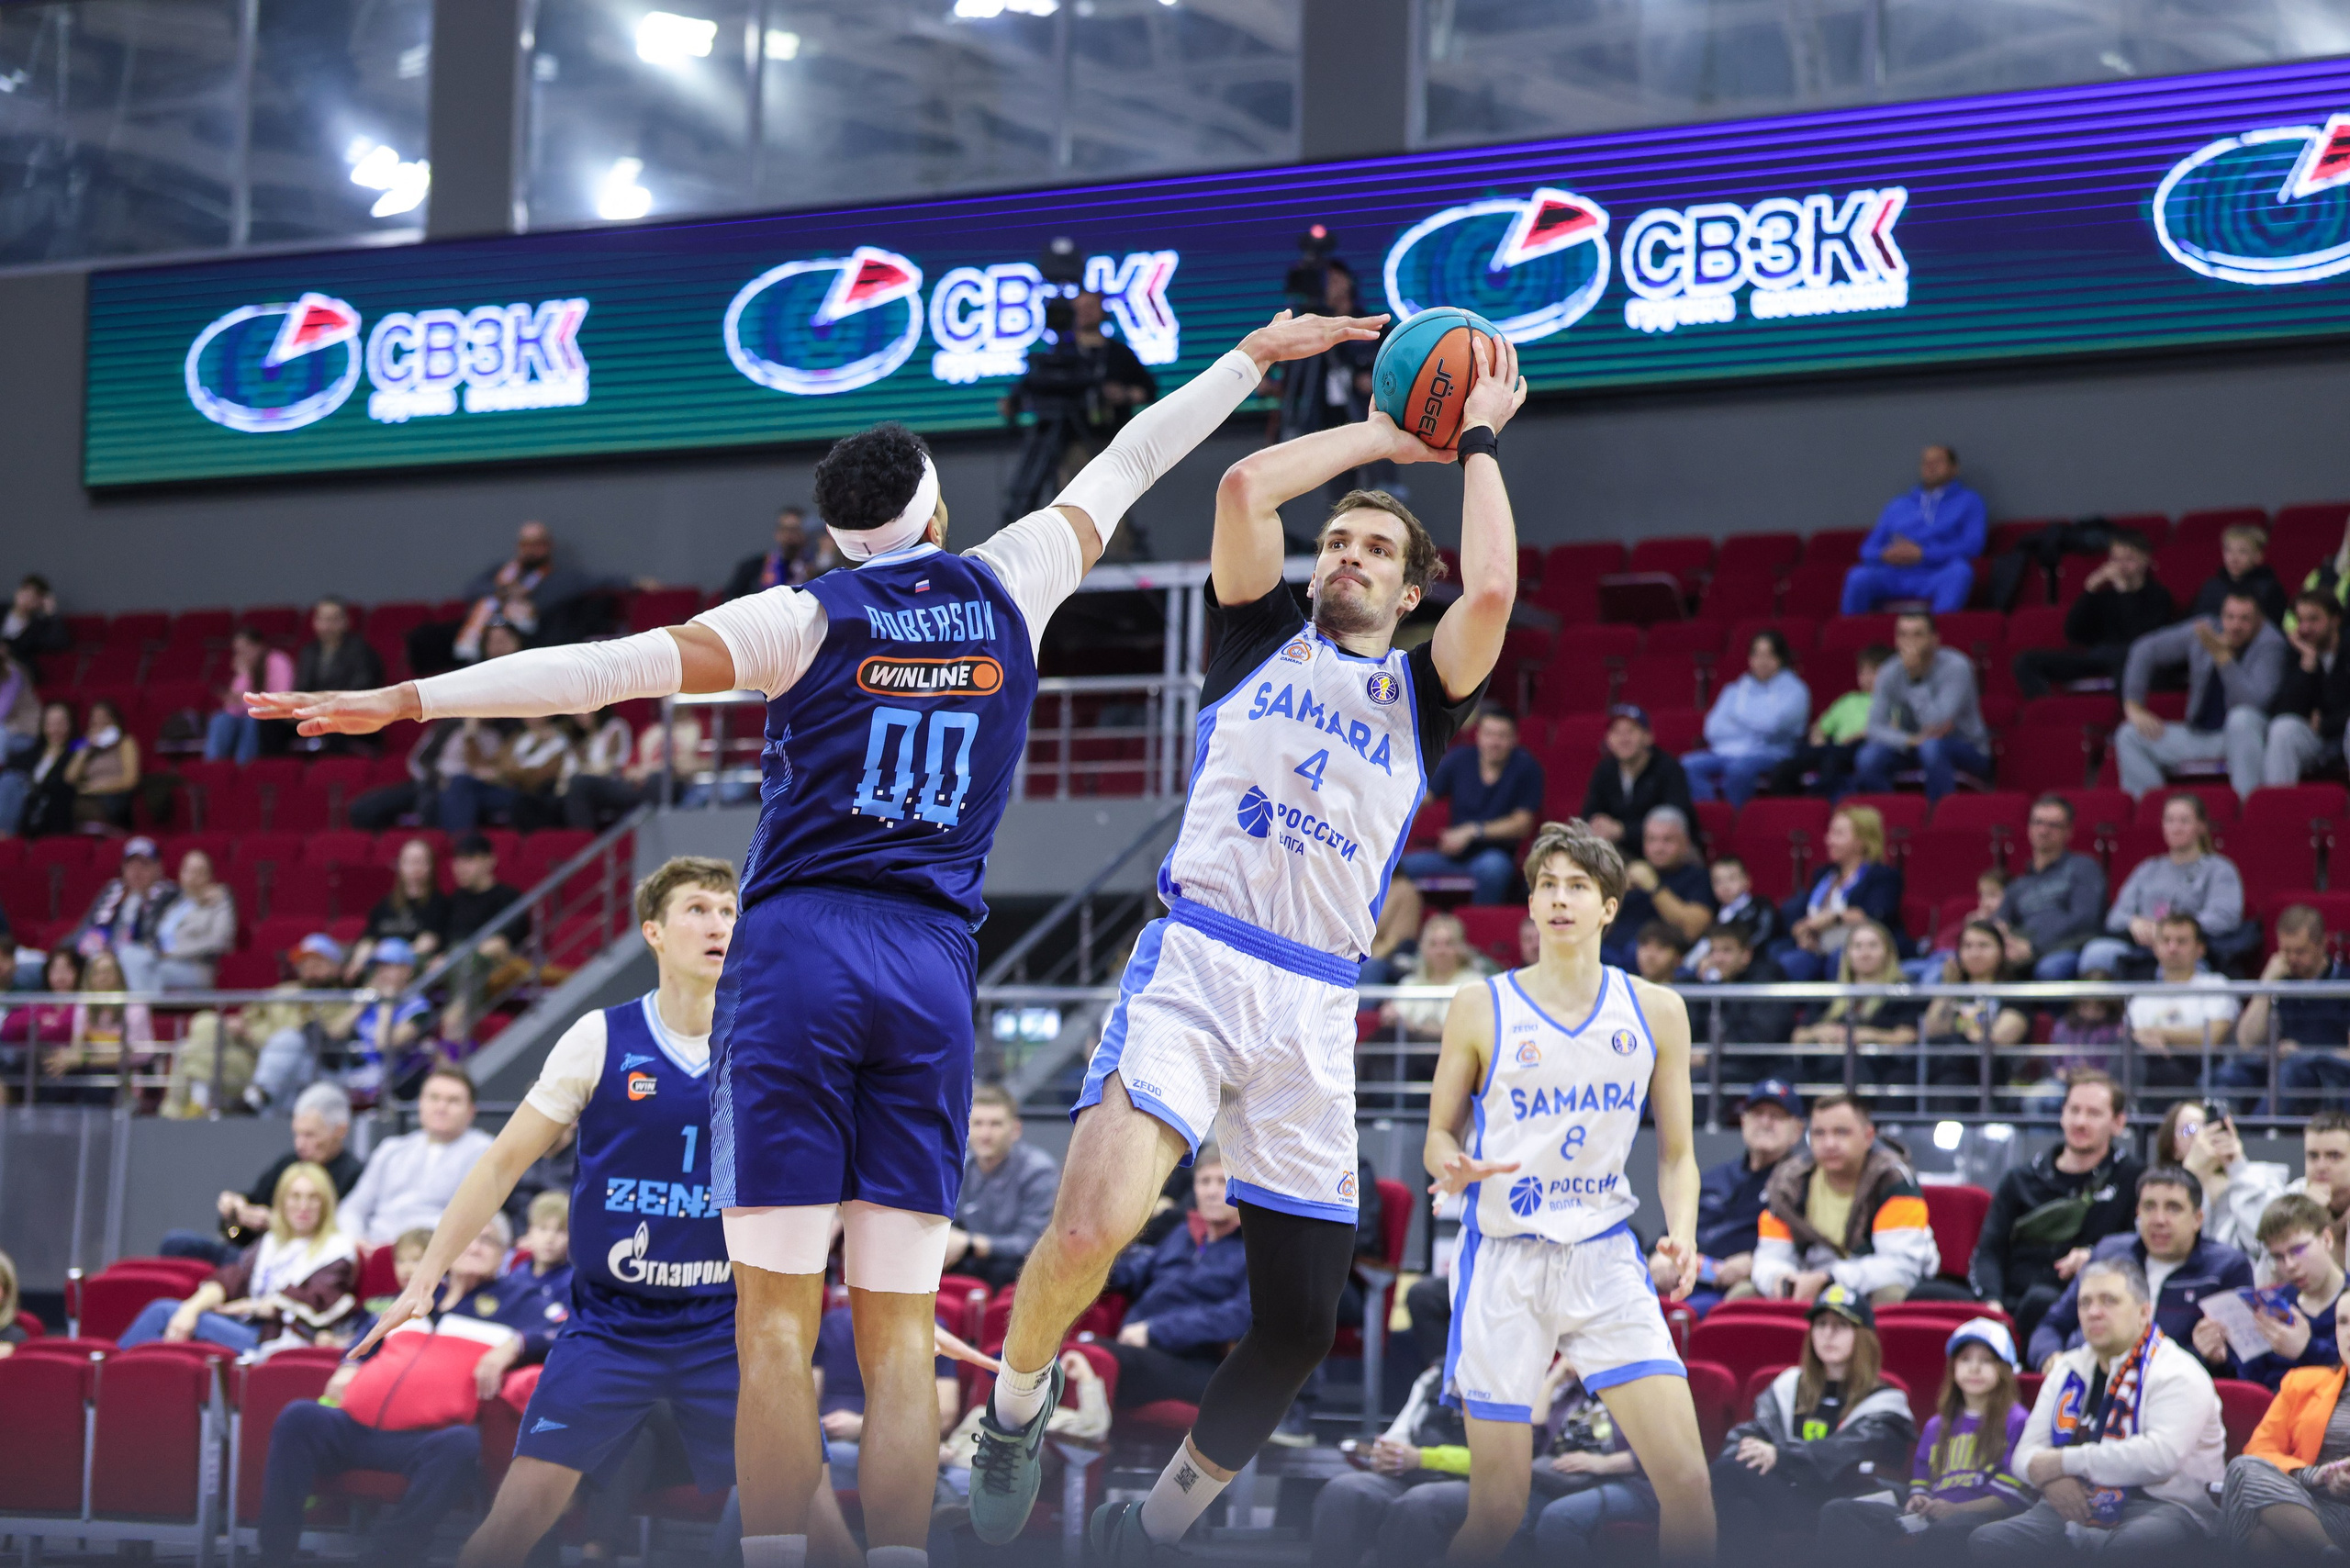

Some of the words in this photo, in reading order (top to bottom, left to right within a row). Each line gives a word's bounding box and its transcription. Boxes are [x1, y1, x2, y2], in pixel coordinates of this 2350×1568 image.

[929, 252, 1179, 353] СВК
[1417, 358, 1454, 437] JÖGEL
[864, 601, 996, 642] ROBERSON
[869, 665, 970, 689] WINLINE
[1248, 682, 1392, 777] SAMARA
[852, 706, 979, 829] 00
[1294, 748, 1329, 792] 4
[1510, 1081, 1636, 1122] SAMARA
[681, 1125, 699, 1173] 1
[1560, 1125, 1587, 1162] 8
[646, 1260, 732, 1287] ГАЗПРОМ
